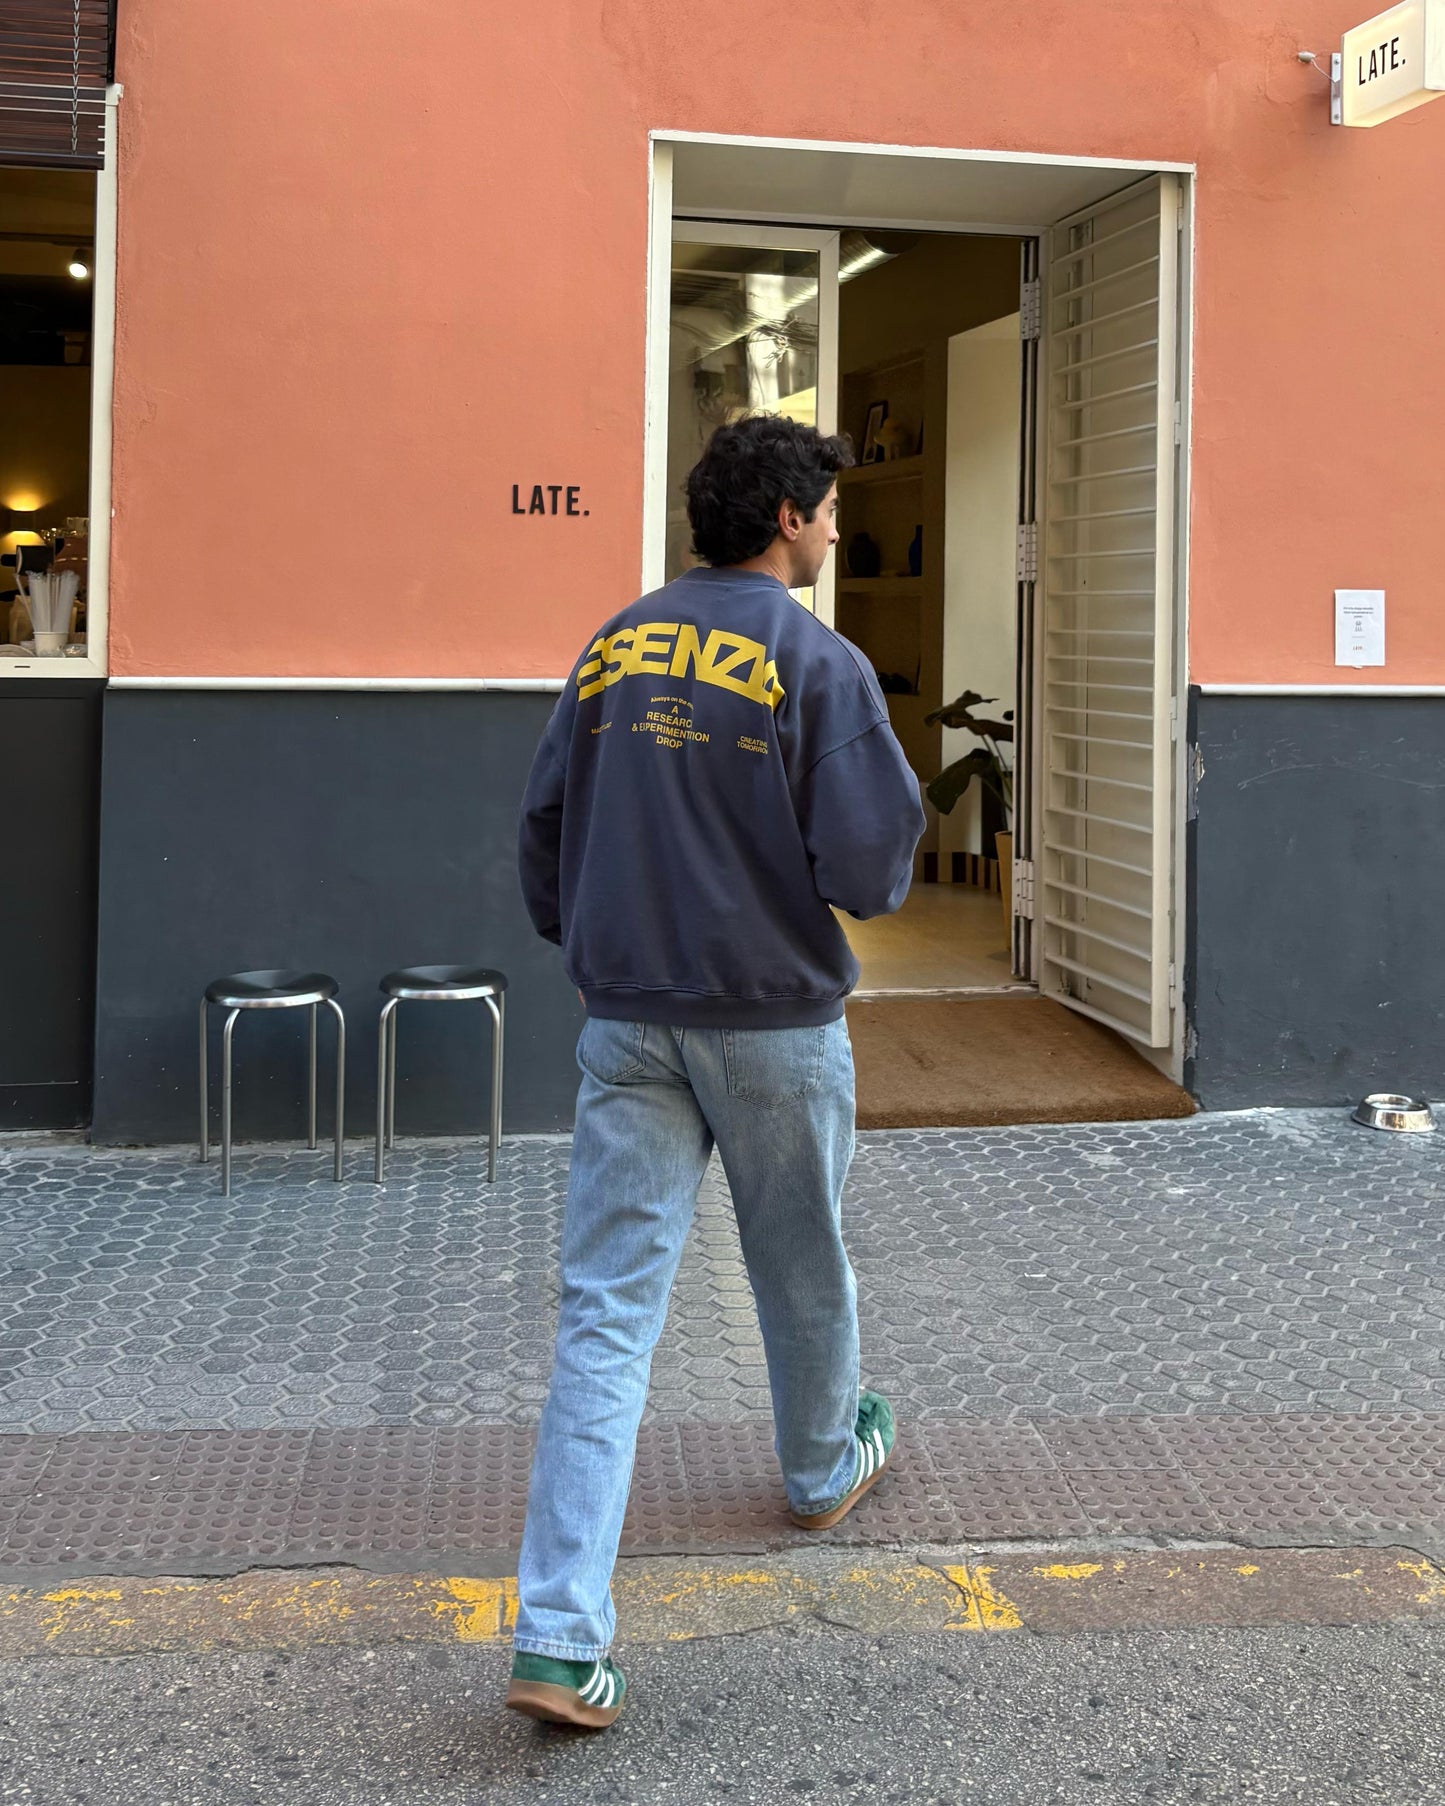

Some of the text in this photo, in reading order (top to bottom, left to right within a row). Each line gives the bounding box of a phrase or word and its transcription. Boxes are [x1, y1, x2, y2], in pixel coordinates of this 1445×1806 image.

[1358, 36, 1406, 86] LATE.
[512, 484, 590, 516] LATE.
[671, 705, 679, 715] A
[631, 723, 638, 732] &
[656, 735, 683, 749] DROP
